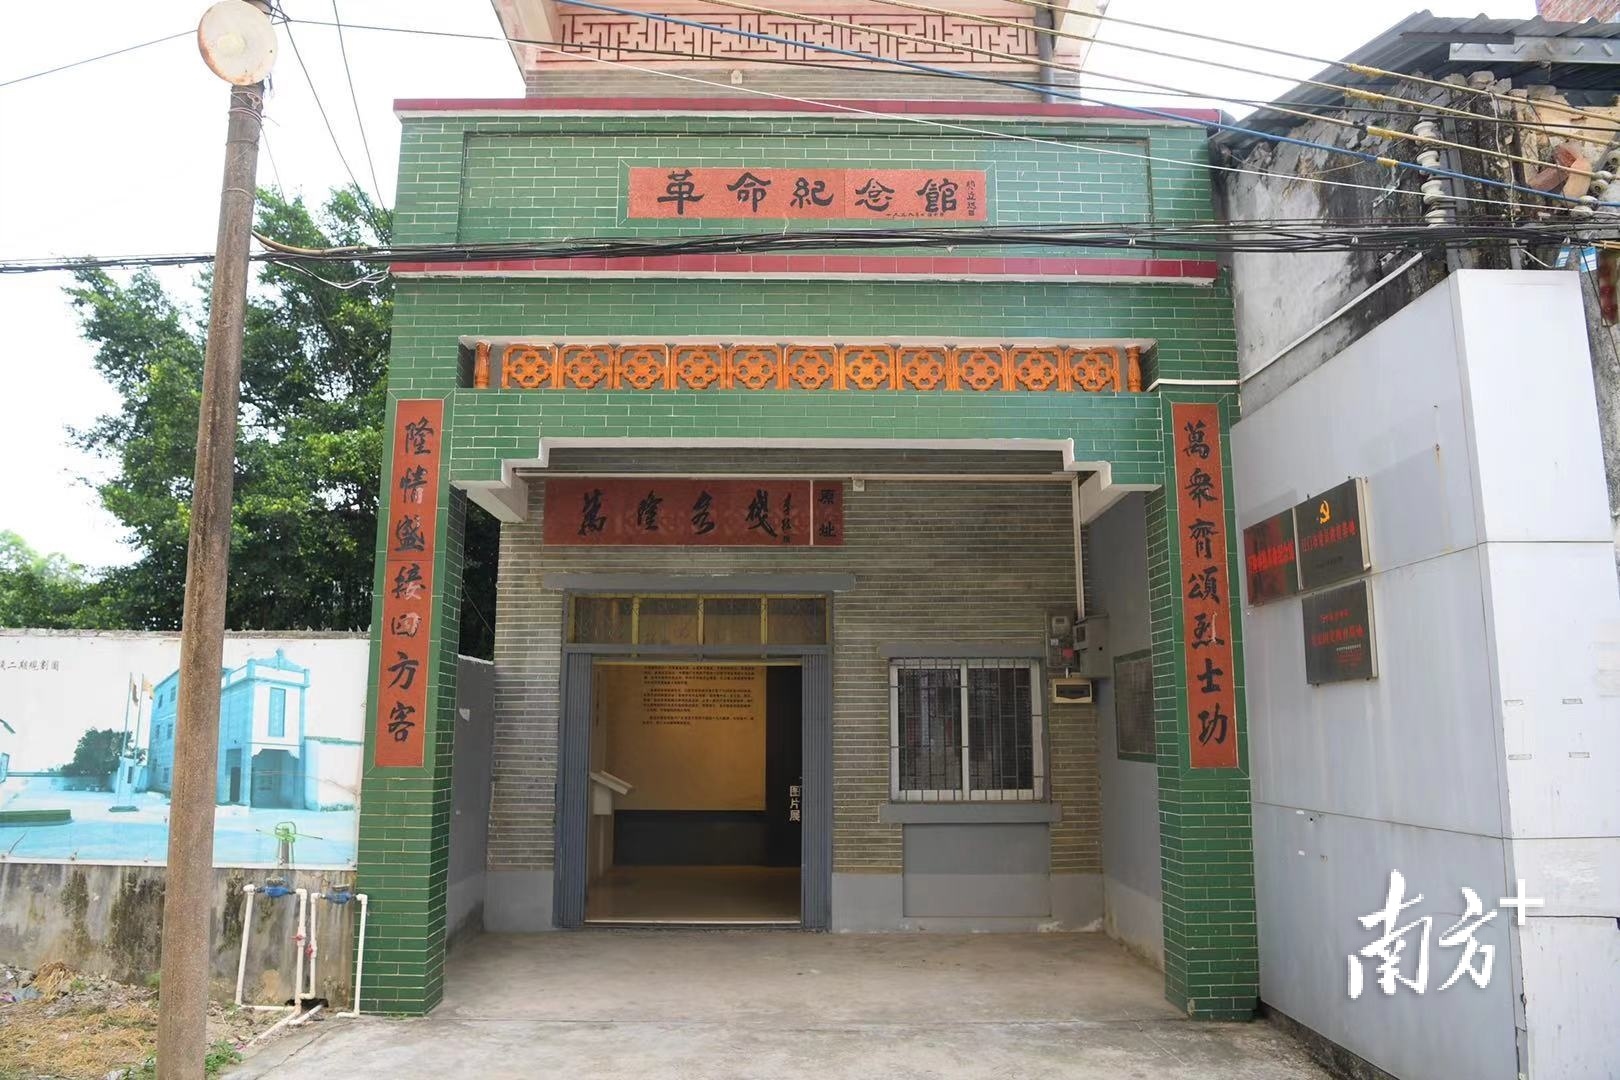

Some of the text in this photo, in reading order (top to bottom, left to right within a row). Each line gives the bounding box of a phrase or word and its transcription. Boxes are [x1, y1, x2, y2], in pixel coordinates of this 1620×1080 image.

[657, 170, 960, 214] 革命紀念館
